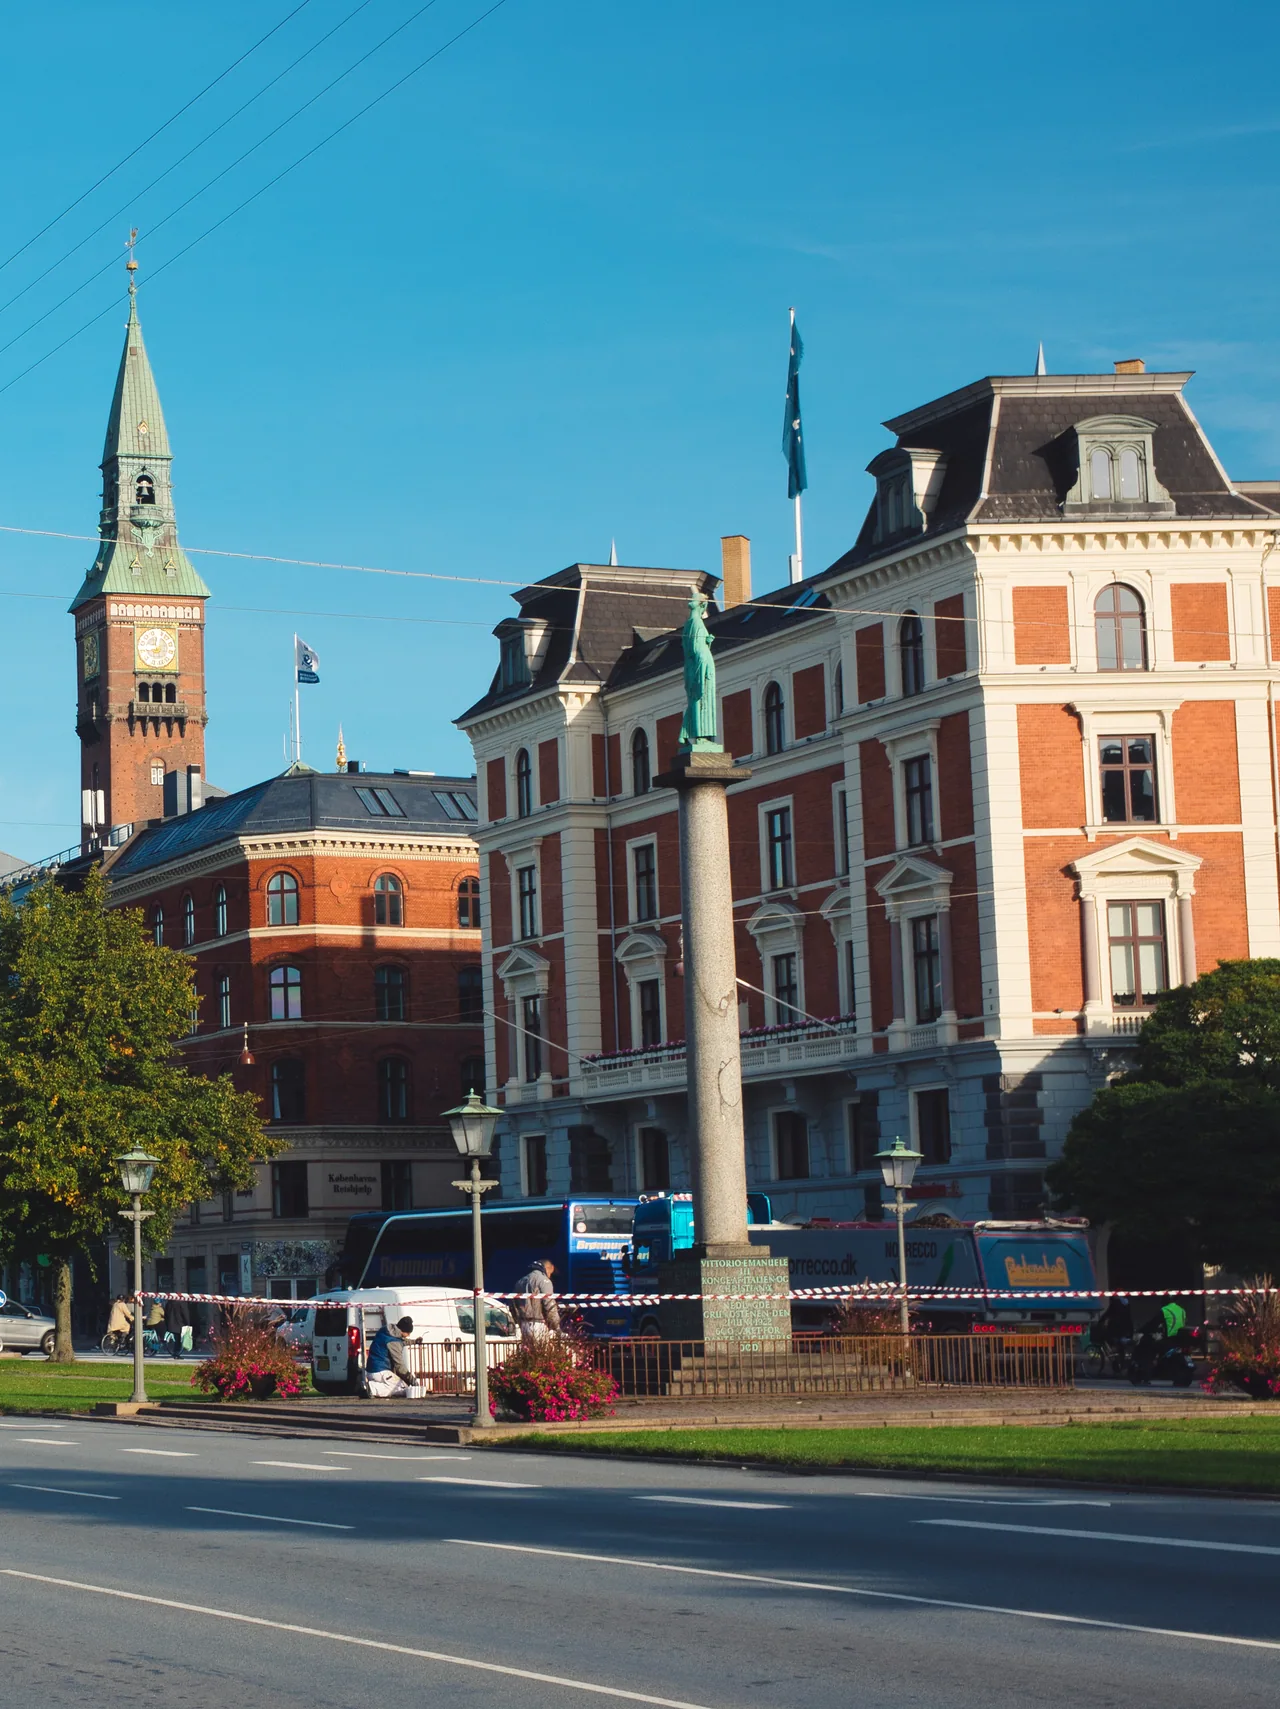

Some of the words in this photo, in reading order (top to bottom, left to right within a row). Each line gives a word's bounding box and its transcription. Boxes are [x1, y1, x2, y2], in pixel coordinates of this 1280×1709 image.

[328, 1174, 377, 1183] Københavns
[885, 1241, 937, 1258] NORECCO
[789, 1254, 857, 1275] orrecco.dk
